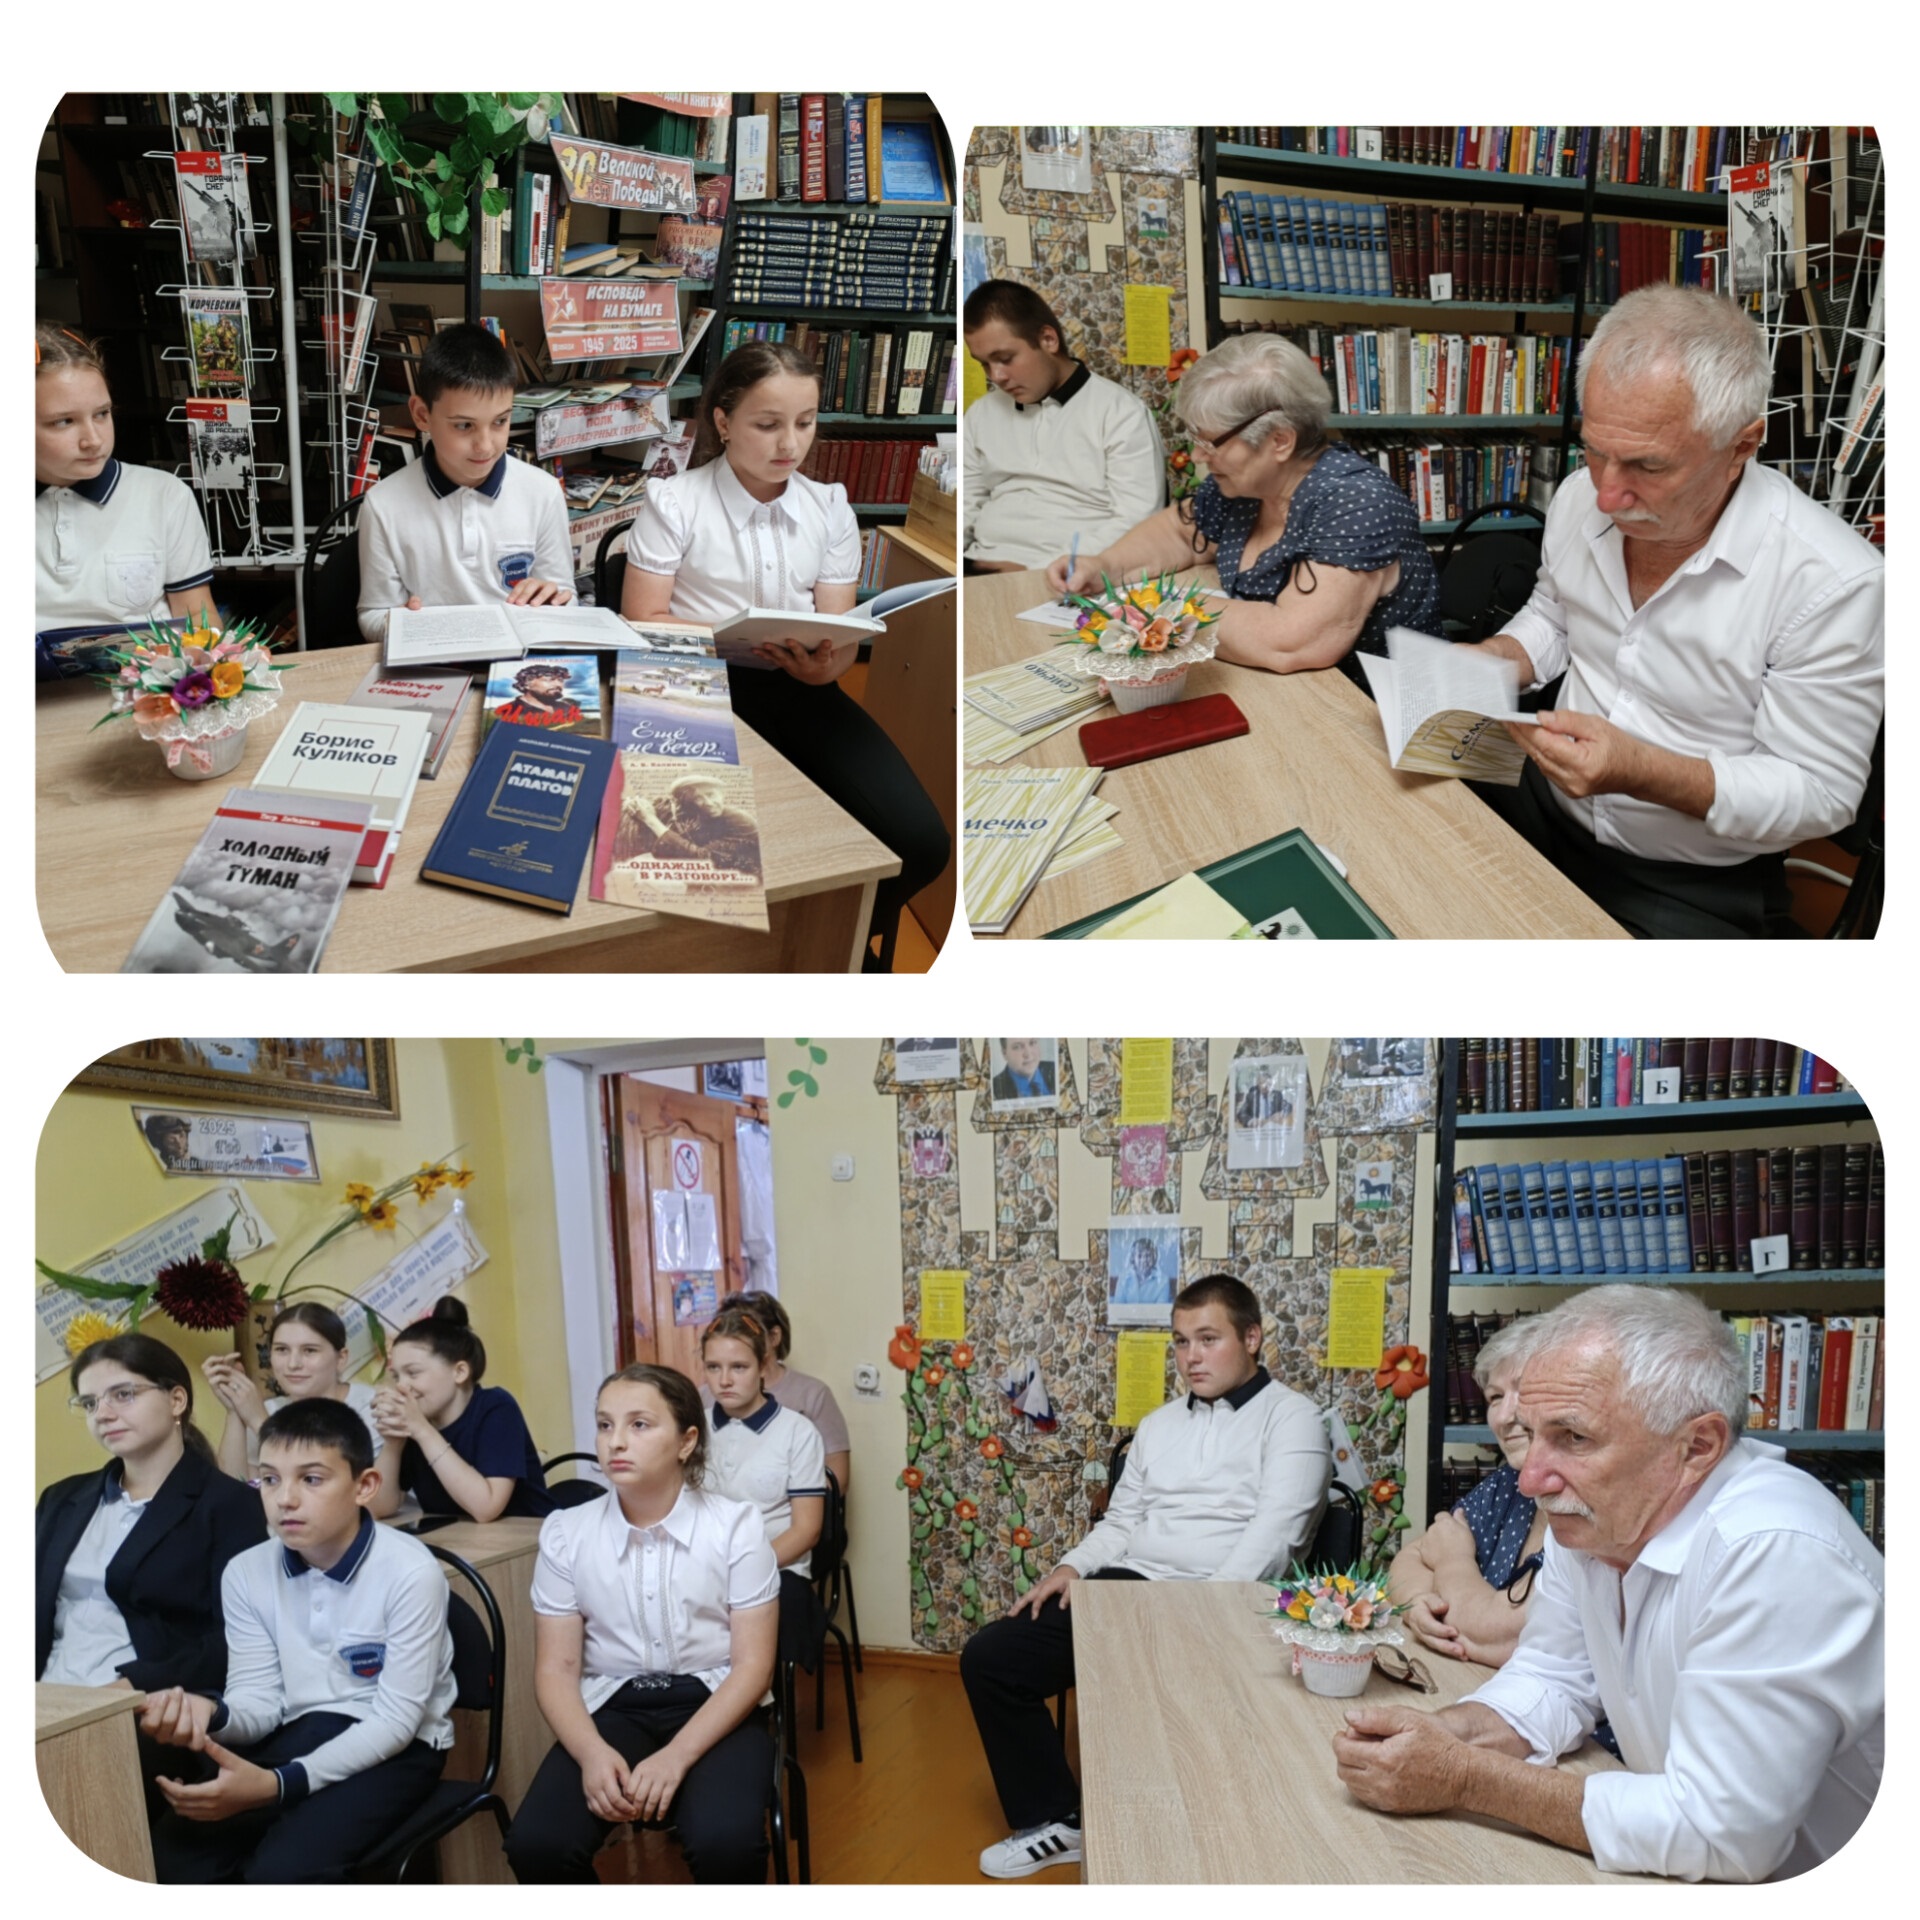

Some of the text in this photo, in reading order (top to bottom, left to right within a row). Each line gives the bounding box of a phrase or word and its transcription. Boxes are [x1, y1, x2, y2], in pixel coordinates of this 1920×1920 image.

[1365, 139, 1375, 151] Б
[598, 151, 656, 181] Великой
[206, 182, 224, 191] СНЕГ
[611, 179, 664, 205] Победы!
[1753, 198, 1771, 209] СНЕГ
[586, 286, 646, 301] ИСПОВЕДЬ
[603, 303, 663, 318] НА БУМАГЕ
[582, 338, 604, 353] 1945
[613, 336, 637, 352] 2025
[586, 415, 613, 428] ПОЛК
[1024, 664, 1080, 694] Семечко
[631, 719, 688, 740] Ещё
[299, 731, 376, 750] Борис
[625, 741, 654, 754] не
[292, 745, 398, 766] Куликов
[510, 762, 580, 784] АТАМАН
[507, 775, 574, 797] ПЛАТОВ
[219, 838, 331, 867] ХОЛОДНЫЙ
[226, 864, 300, 889] ТУМАН
[640, 872, 649, 880] В
[1656, 1080, 1669, 1095] Б
[199, 1118, 236, 1136] 2025
[214, 1138, 242, 1156] Год
[1764, 1251, 1777, 1267] Г
